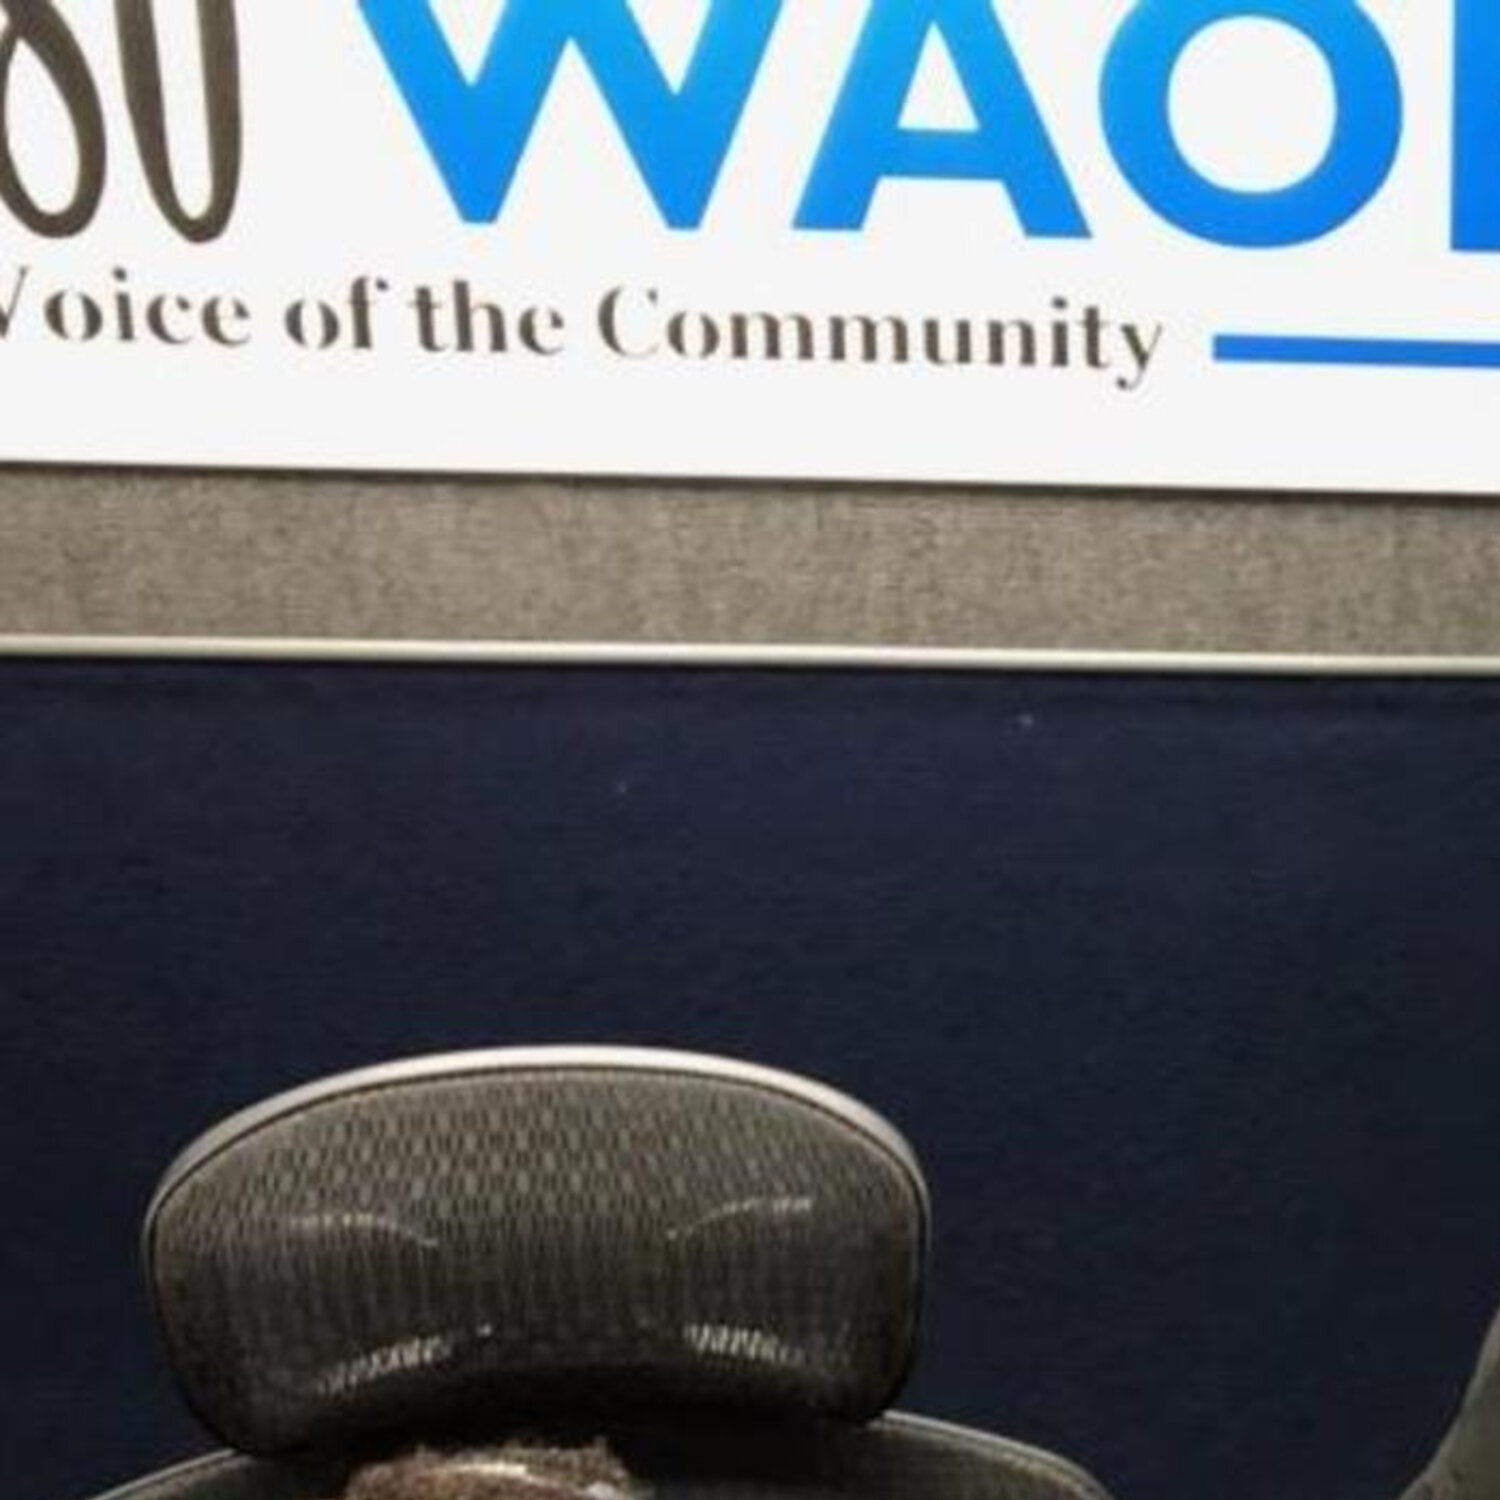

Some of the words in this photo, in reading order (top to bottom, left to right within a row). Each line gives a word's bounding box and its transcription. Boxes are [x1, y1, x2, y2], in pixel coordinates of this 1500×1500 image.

[284, 275, 389, 351] of
[409, 280, 565, 356] the
[599, 285, 1163, 390] Community
